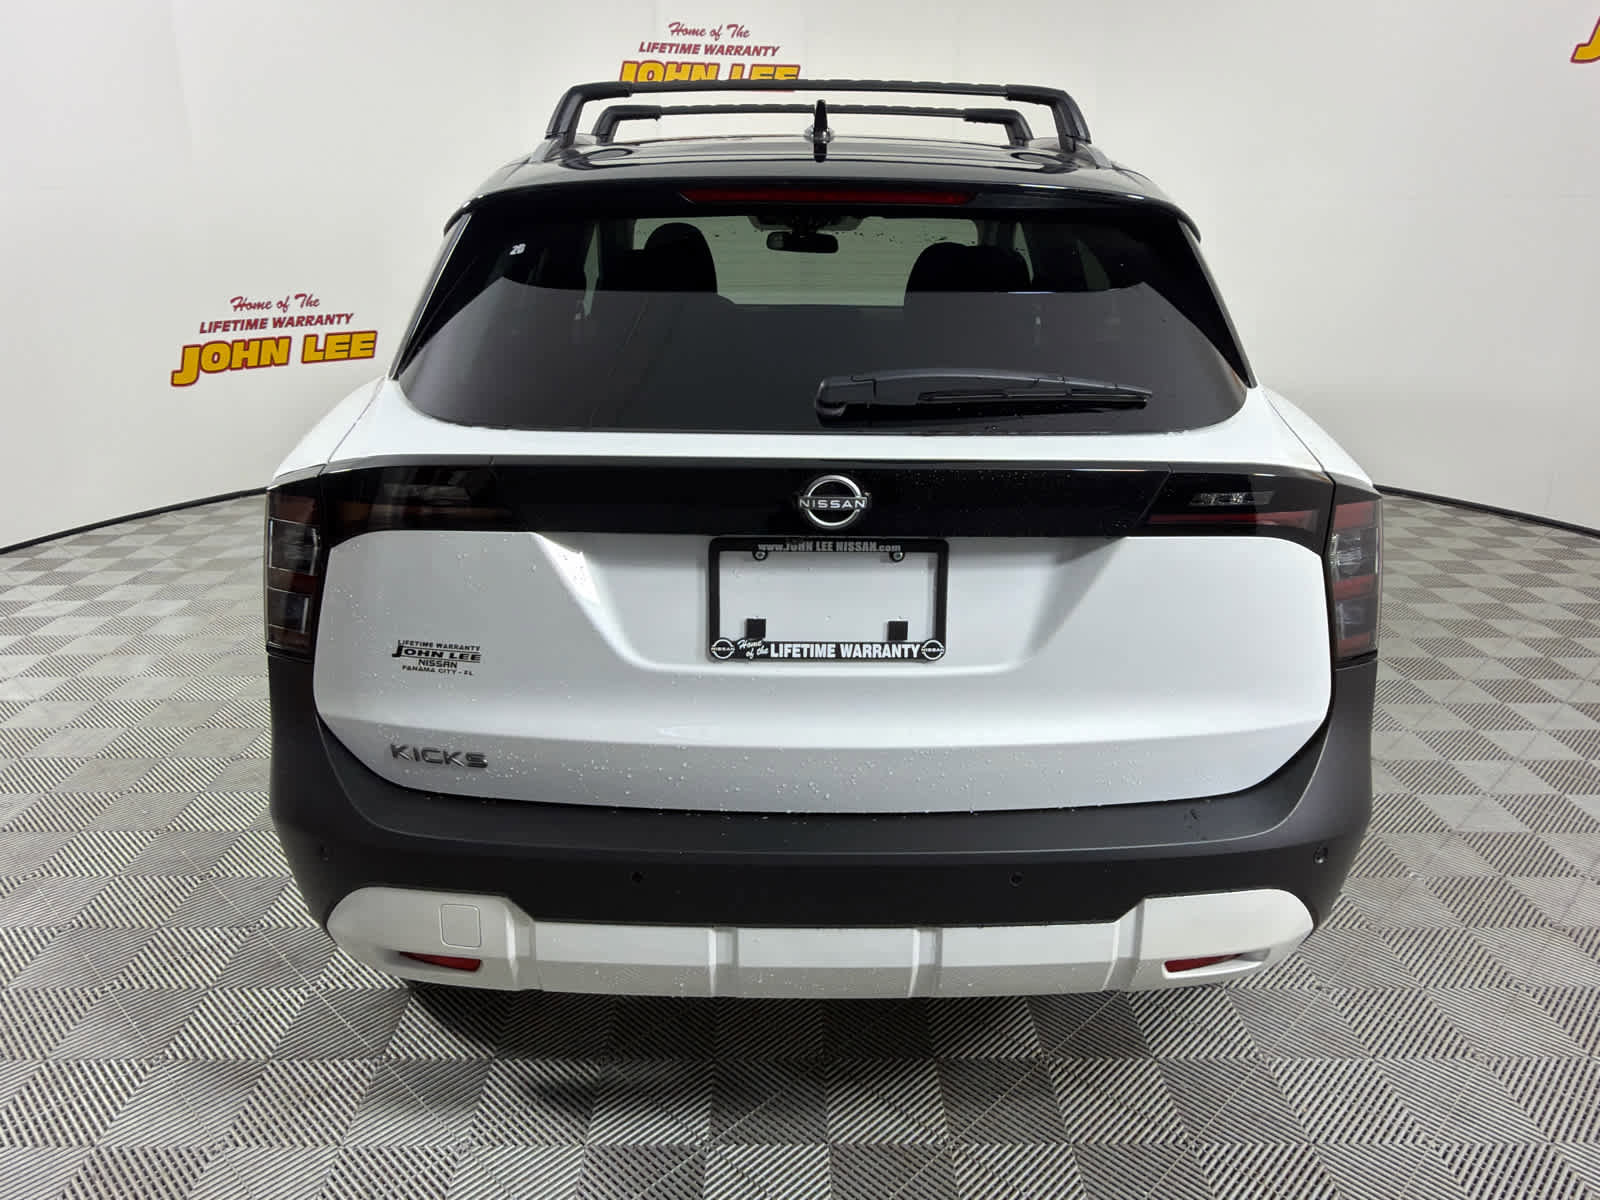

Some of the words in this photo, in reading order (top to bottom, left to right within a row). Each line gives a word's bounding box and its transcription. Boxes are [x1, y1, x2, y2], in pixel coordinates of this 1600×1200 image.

[669, 22, 706, 38] Home
[710, 25, 723, 40] of
[727, 24, 750, 38] The
[638, 41, 701, 55] LIFETIME
[704, 44, 780, 57] WARRANTY
[230, 296, 272, 312] Home
[276, 296, 291, 313] of
[294, 293, 320, 308] The
[200, 318, 268, 334] LIFETIME
[272, 313, 354, 329] WARRANTY
[171, 336, 292, 387] JOHN
[301, 330, 378, 363] LEE
[799, 499, 866, 509] NISSAN
[815, 541, 833, 552] LEE
[392, 643, 444, 659] JOHN
[449, 652, 481, 661] LEE
[436, 643, 480, 652] WARRANTY
[737, 640, 762, 649] Home
[770, 643, 836, 658] LIFETIME
[840, 643, 920, 658] WARRANTY
[418, 659, 458, 669] NISSAN
[390, 743, 488, 768] KICKS
